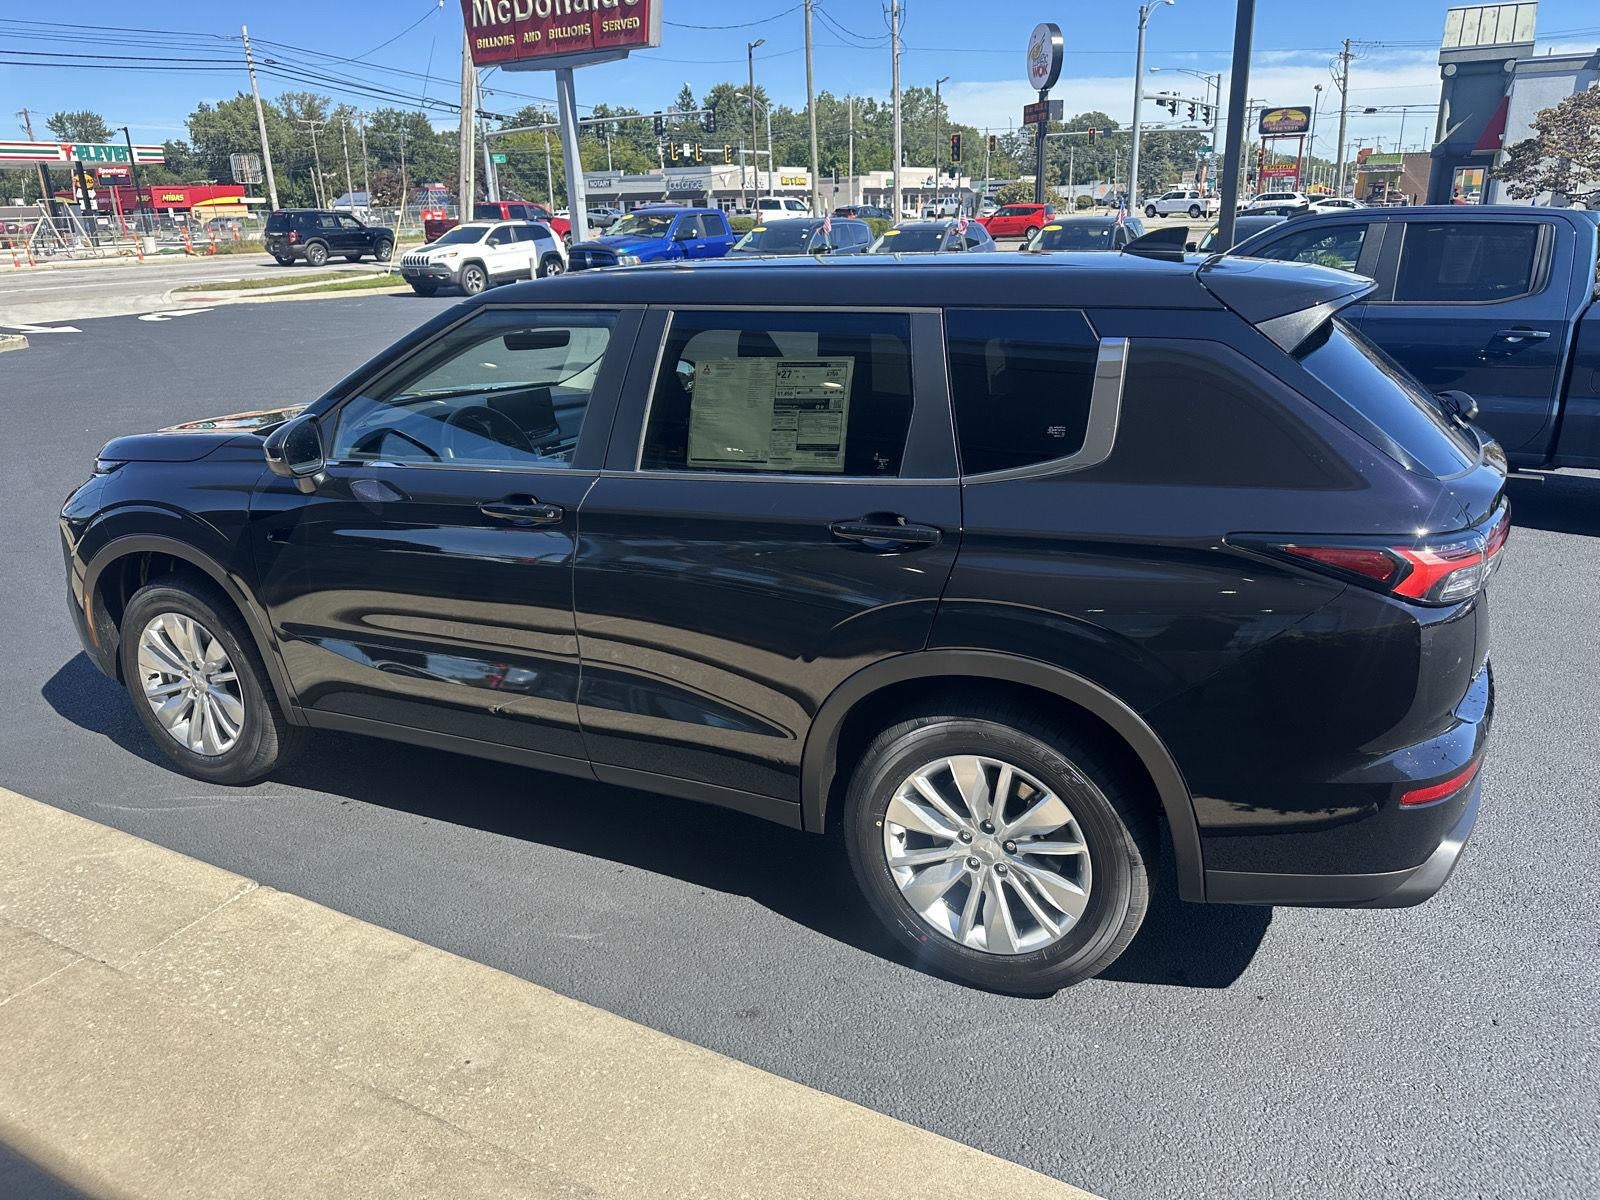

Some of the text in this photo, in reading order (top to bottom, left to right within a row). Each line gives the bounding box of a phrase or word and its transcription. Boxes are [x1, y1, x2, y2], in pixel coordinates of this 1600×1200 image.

[472, 0, 640, 27] McDona
[477, 17, 640, 48] BILLIONS AND BILLIONS SERVED
[1032, 64, 1048, 77] WOK
[98, 167, 128, 175] Speedway
[781, 370, 792, 379] 27
